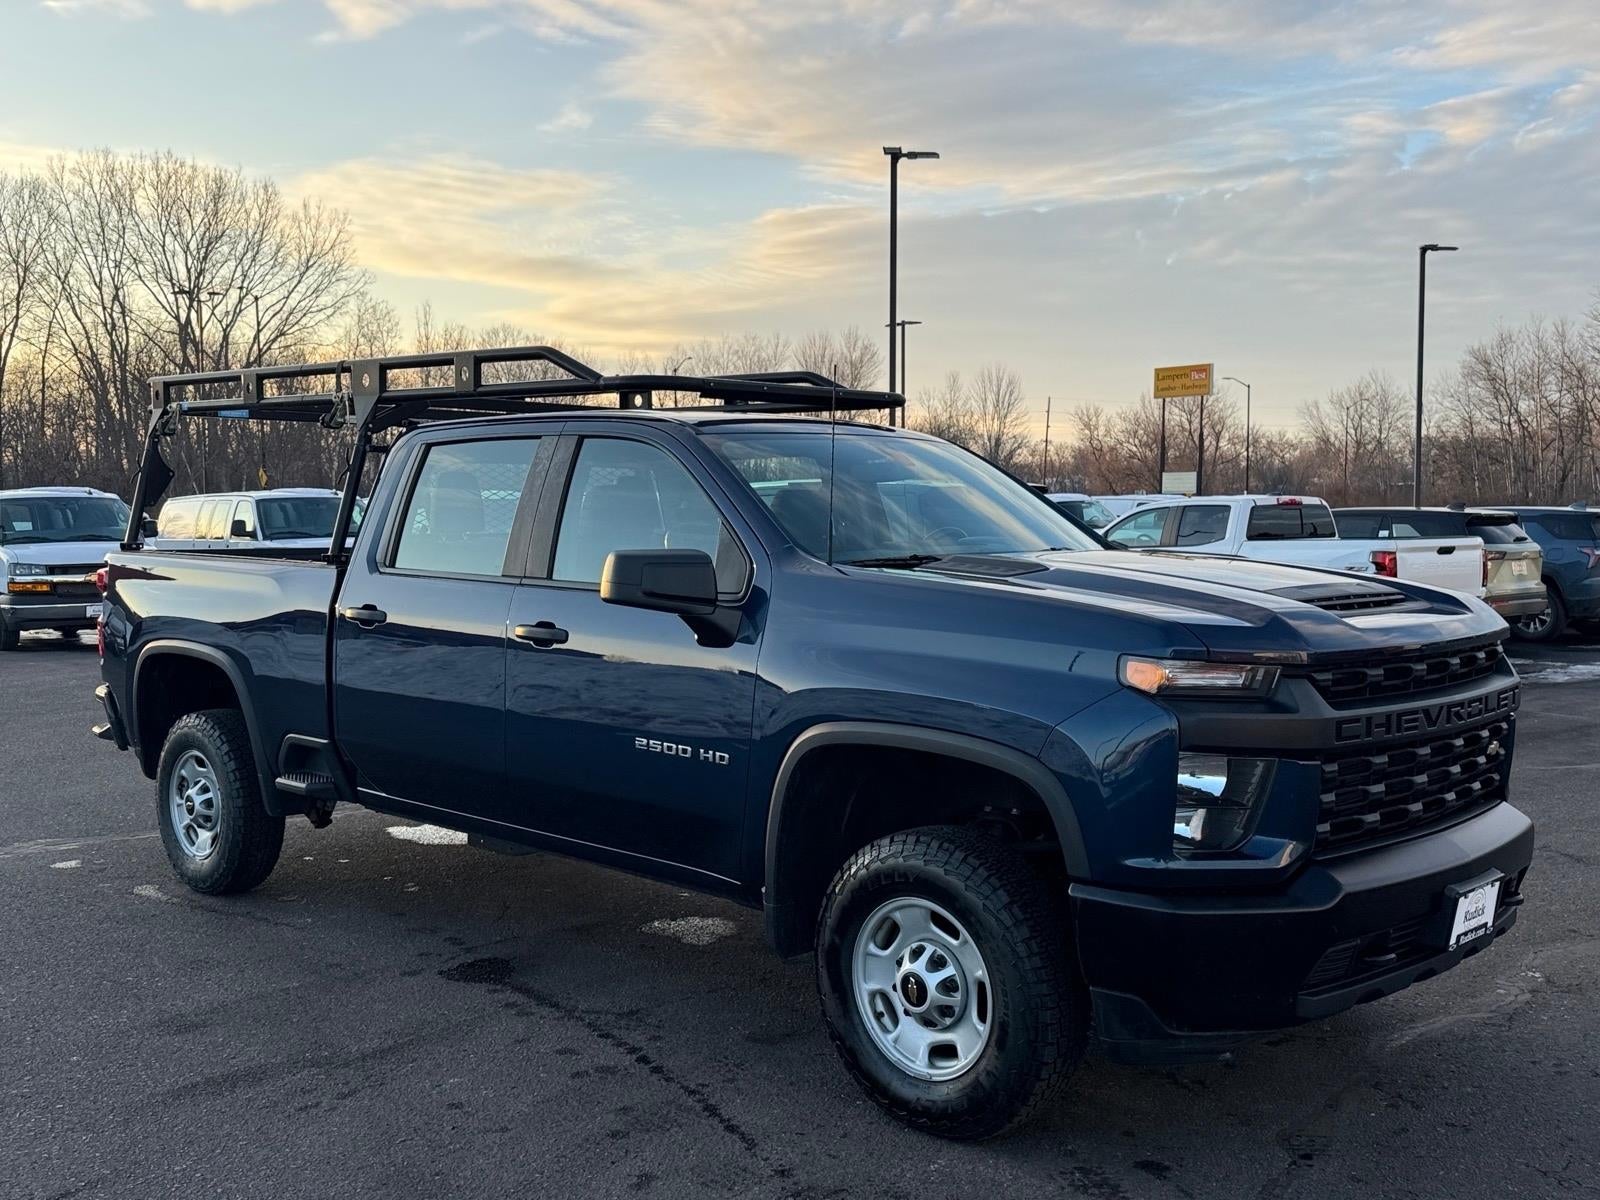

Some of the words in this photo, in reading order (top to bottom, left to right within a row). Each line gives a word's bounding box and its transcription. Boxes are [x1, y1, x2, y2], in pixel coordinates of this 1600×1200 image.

[1334, 686, 1519, 744] CHEVROLET
[634, 737, 692, 758] 2500
[699, 748, 730, 765] HD
